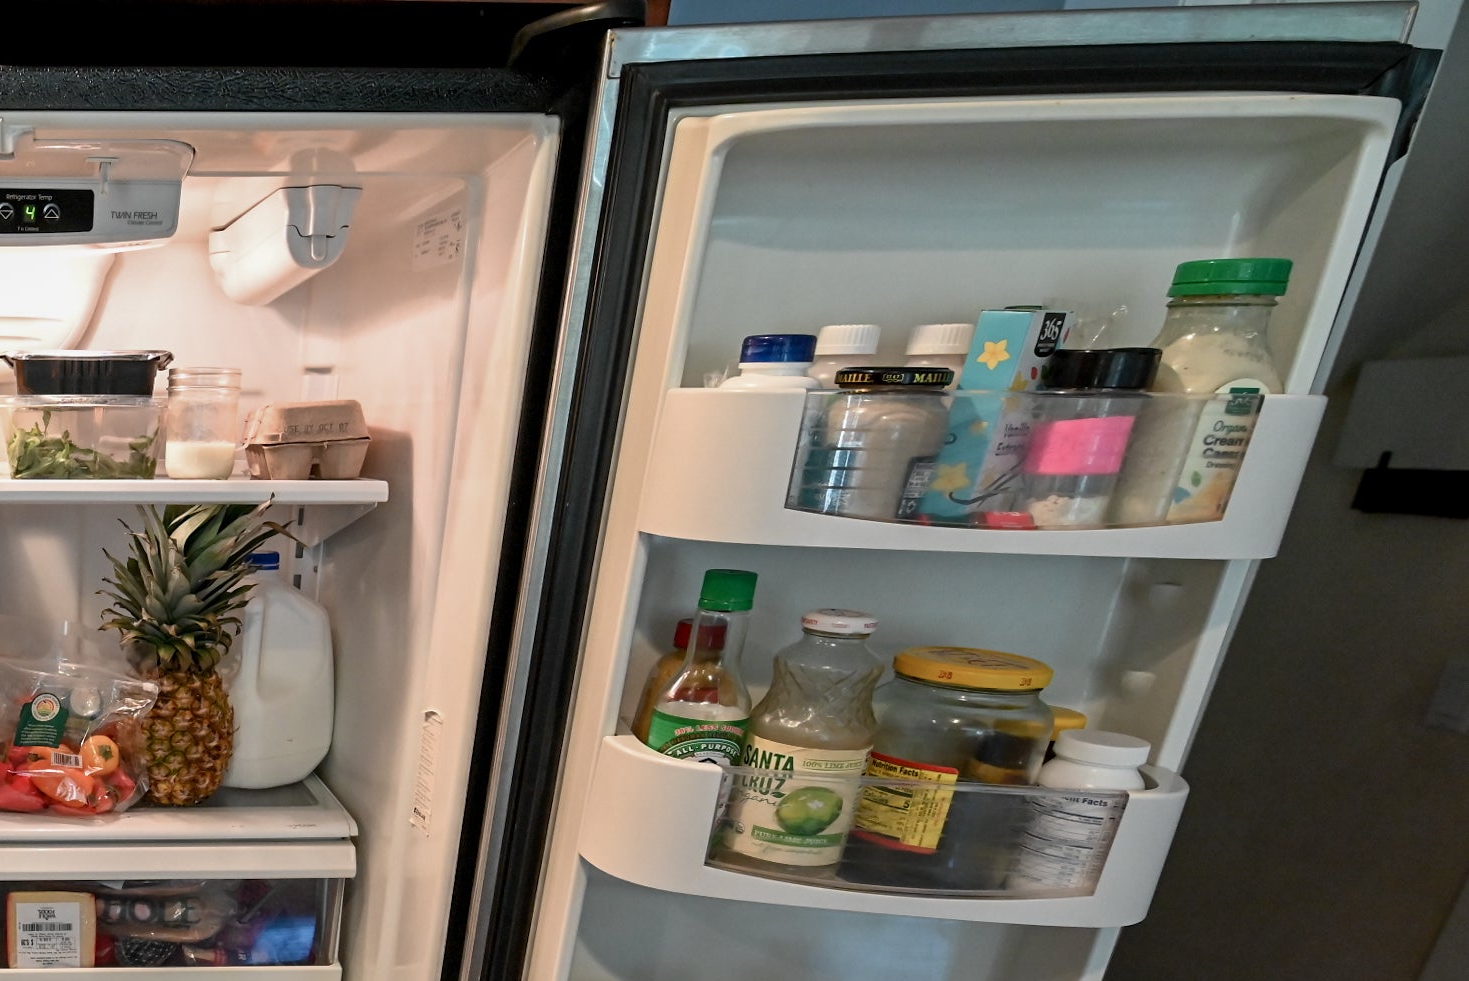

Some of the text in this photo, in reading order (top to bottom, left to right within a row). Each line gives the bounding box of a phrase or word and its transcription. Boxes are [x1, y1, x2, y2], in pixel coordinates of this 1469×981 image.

[6, 193, 37, 203] Refrigerator
[25, 206, 36, 220] 4
[110, 211, 158, 220] TWIN FRESH
[1040, 318, 1063, 341] 365
[914, 373, 951, 383] MAILL
[1213, 420, 1248, 434] Organ
[1203, 434, 1249, 447] Cream
[743, 744, 795, 772] SANTA
[802, 760, 823, 768] 100%
[871, 759, 919, 777] Nutrition Facts
[1081, 798, 1108, 807] Facts
